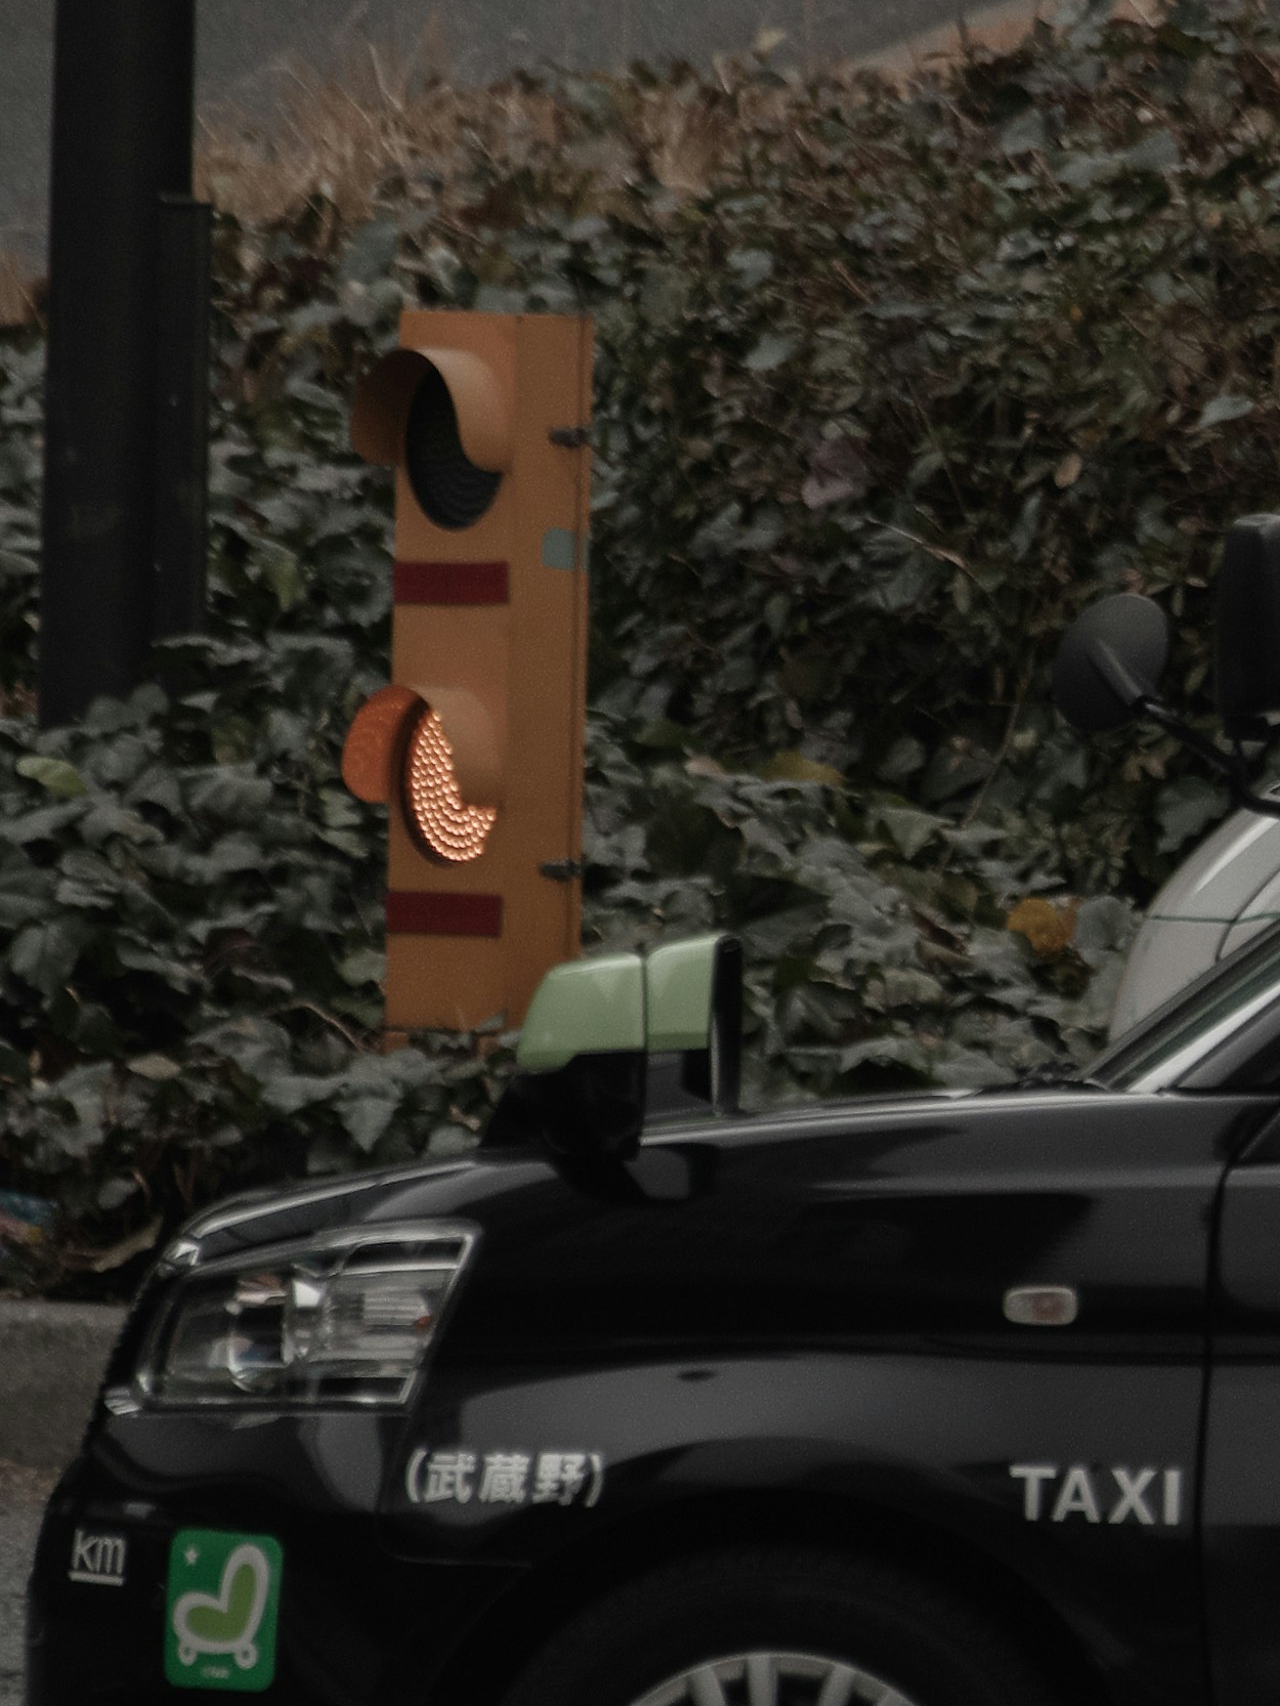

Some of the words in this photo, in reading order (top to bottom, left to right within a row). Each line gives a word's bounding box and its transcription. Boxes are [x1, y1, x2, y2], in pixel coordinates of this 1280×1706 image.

[404, 1447, 604, 1509] (武蔵野)
[1008, 1464, 1182, 1526] TAXI
[69, 1528, 127, 1581] km
